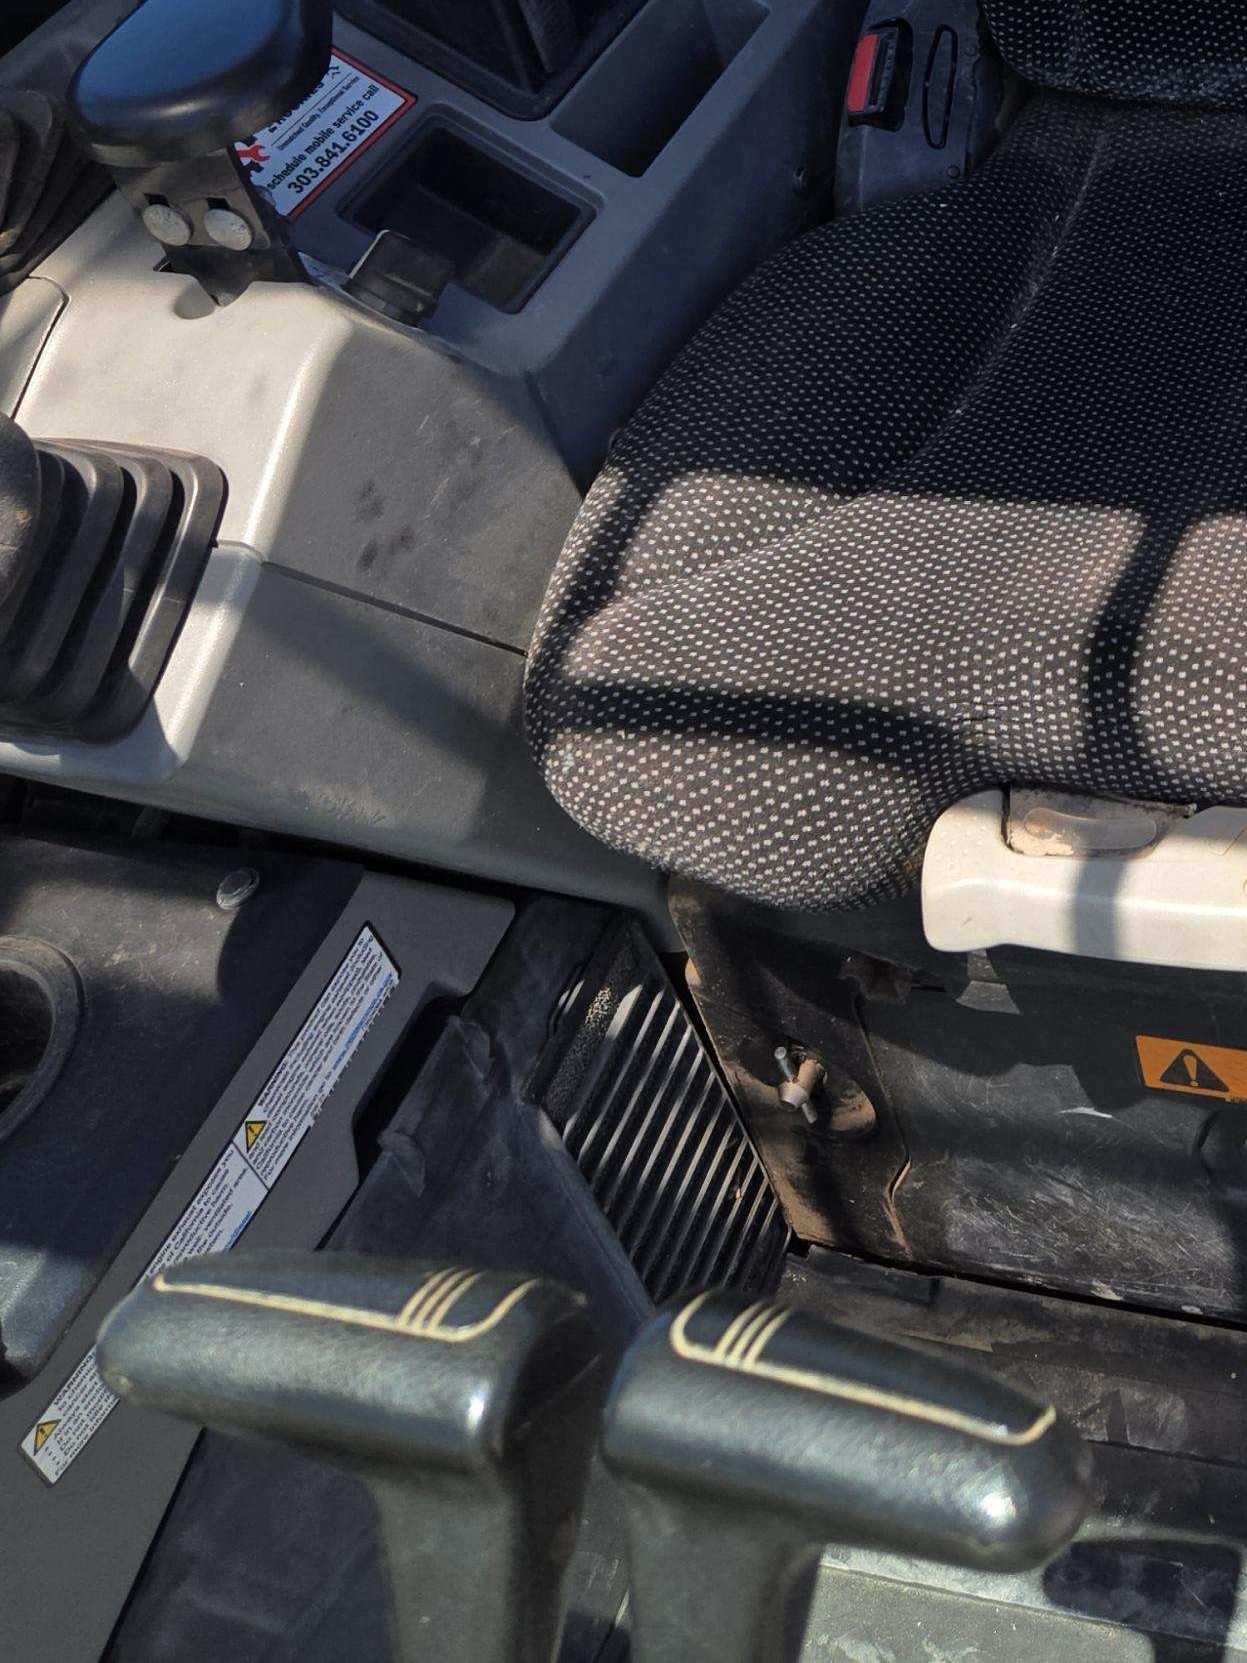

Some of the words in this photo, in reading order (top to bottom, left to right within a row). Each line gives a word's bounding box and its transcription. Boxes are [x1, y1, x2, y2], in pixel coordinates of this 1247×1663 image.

[267, 154, 307, 190] schedule
[305, 127, 335, 155] mobile
[333, 99, 364, 128] service
[362, 85, 380, 100] call
[288, 110, 379, 194] 303.841.6100
